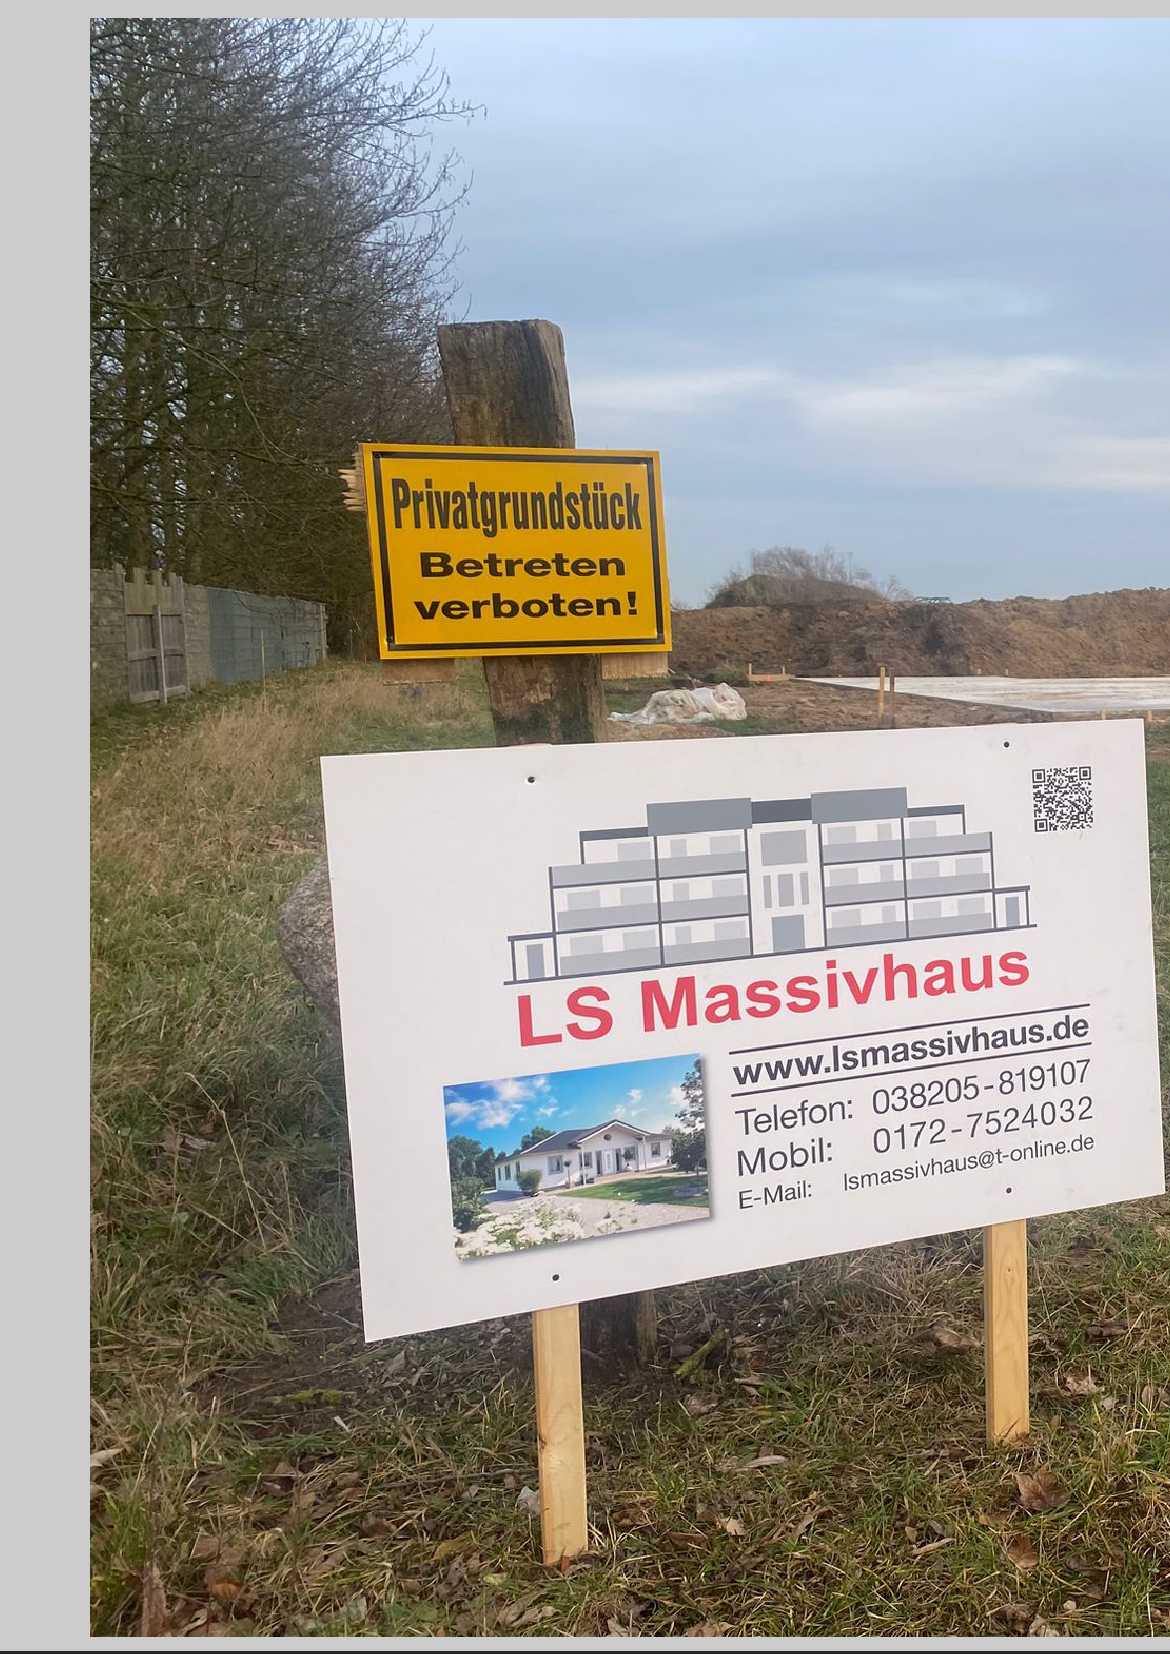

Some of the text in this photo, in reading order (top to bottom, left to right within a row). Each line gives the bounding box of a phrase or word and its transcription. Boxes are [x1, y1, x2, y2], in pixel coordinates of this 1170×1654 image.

[391, 477, 643, 538] Privatgrundstück
[419, 551, 626, 578] Betreten
[414, 591, 638, 621] verboten!
[518, 951, 1030, 1047] LS Massivhaus
[732, 1014, 1090, 1085] www.lsmassivhaus.de
[735, 1058, 1091, 1136] Telefon: 038205-819107
[737, 1095, 1093, 1177] Mobil: 0172-7524032
[738, 1134, 1095, 1210] E-Mail: lsmassivhaus@t-online.de
